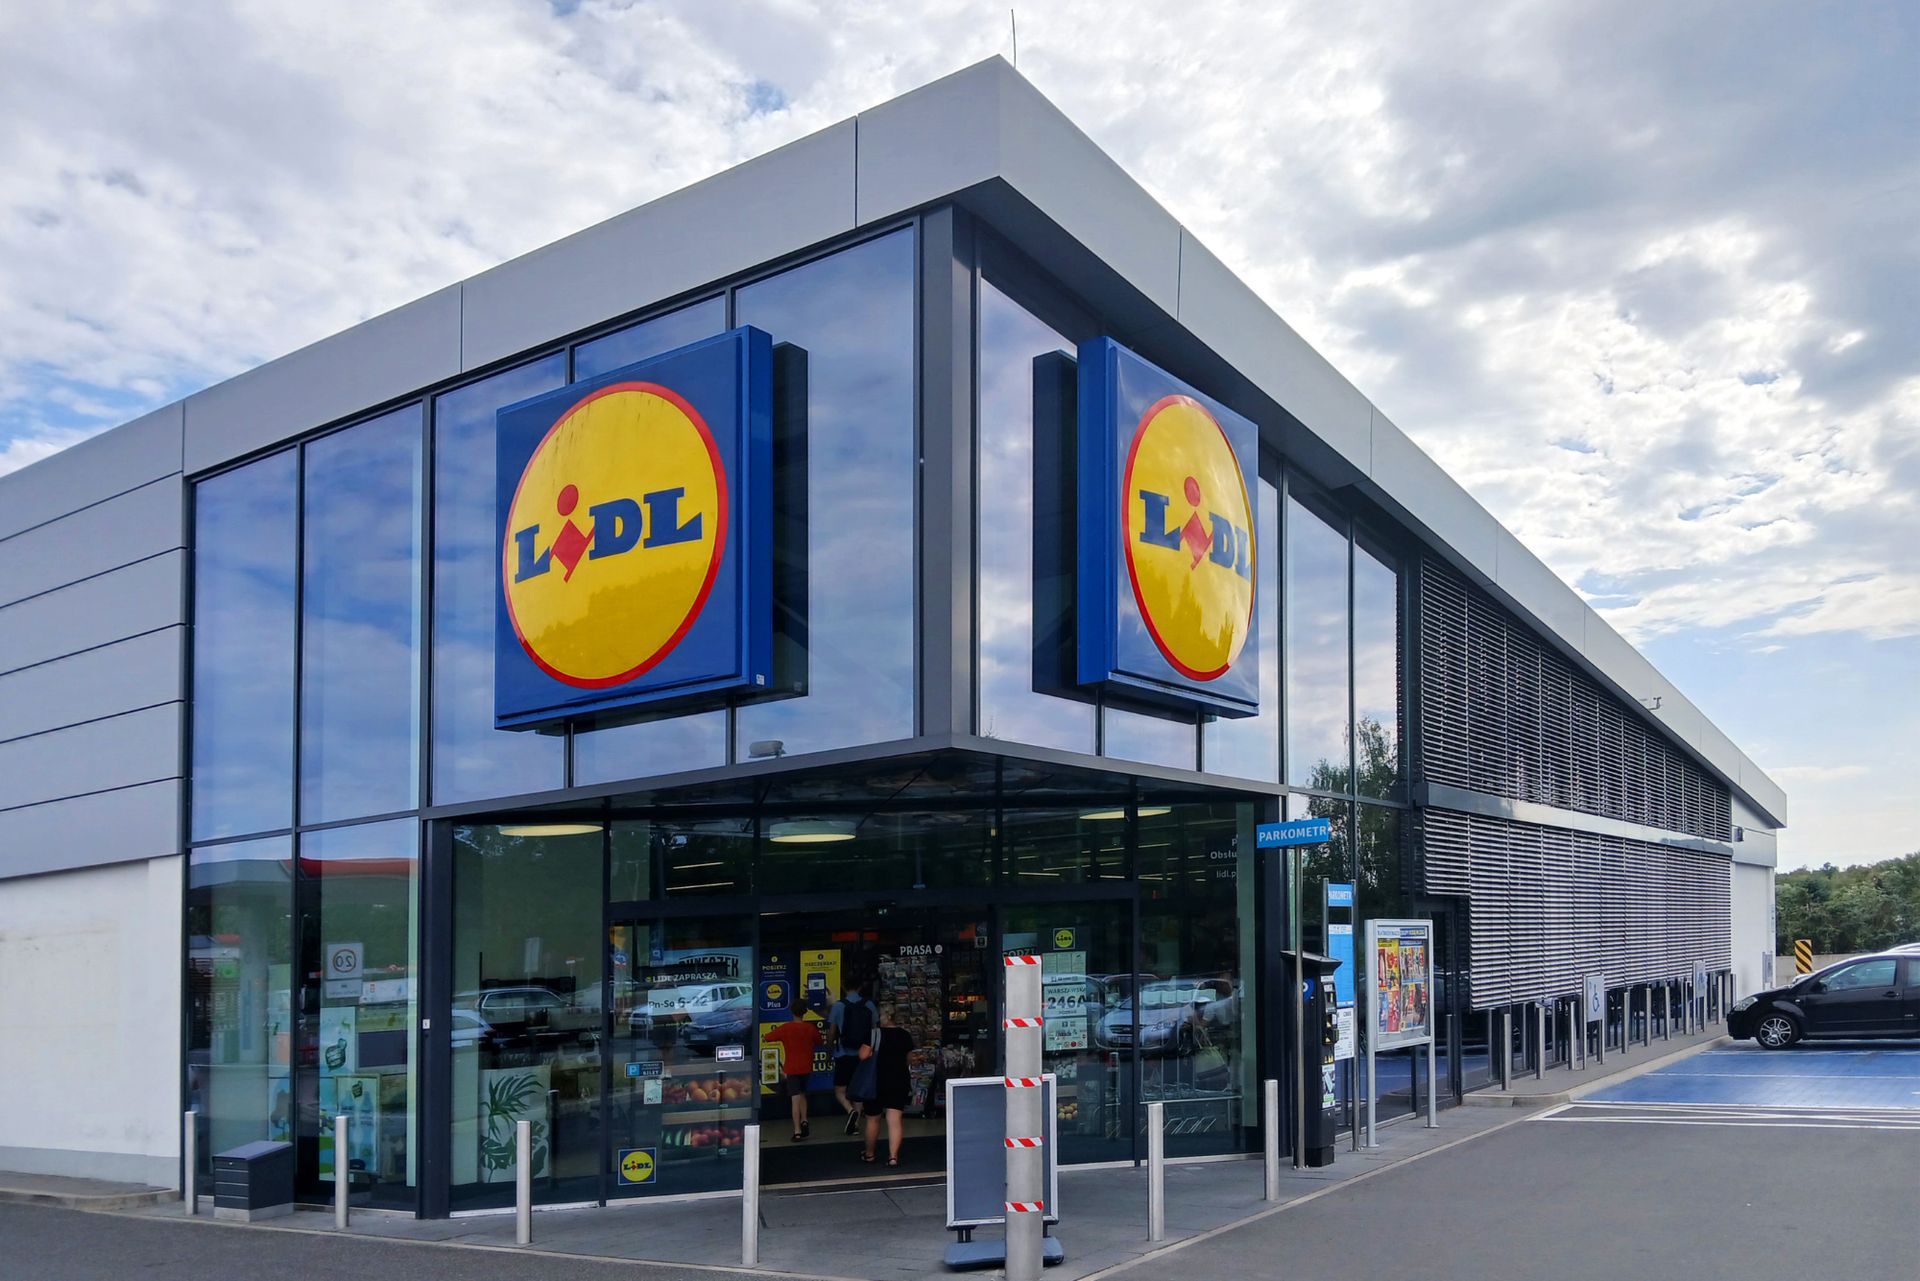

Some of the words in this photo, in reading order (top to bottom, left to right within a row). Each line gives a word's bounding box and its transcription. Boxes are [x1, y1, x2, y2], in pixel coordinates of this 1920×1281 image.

[1259, 826, 1327, 842] PARKOMETR
[900, 944, 932, 956] PRASA
[673, 972, 718, 982] ZAPRASZA
[1048, 995, 1086, 1009] 246A
